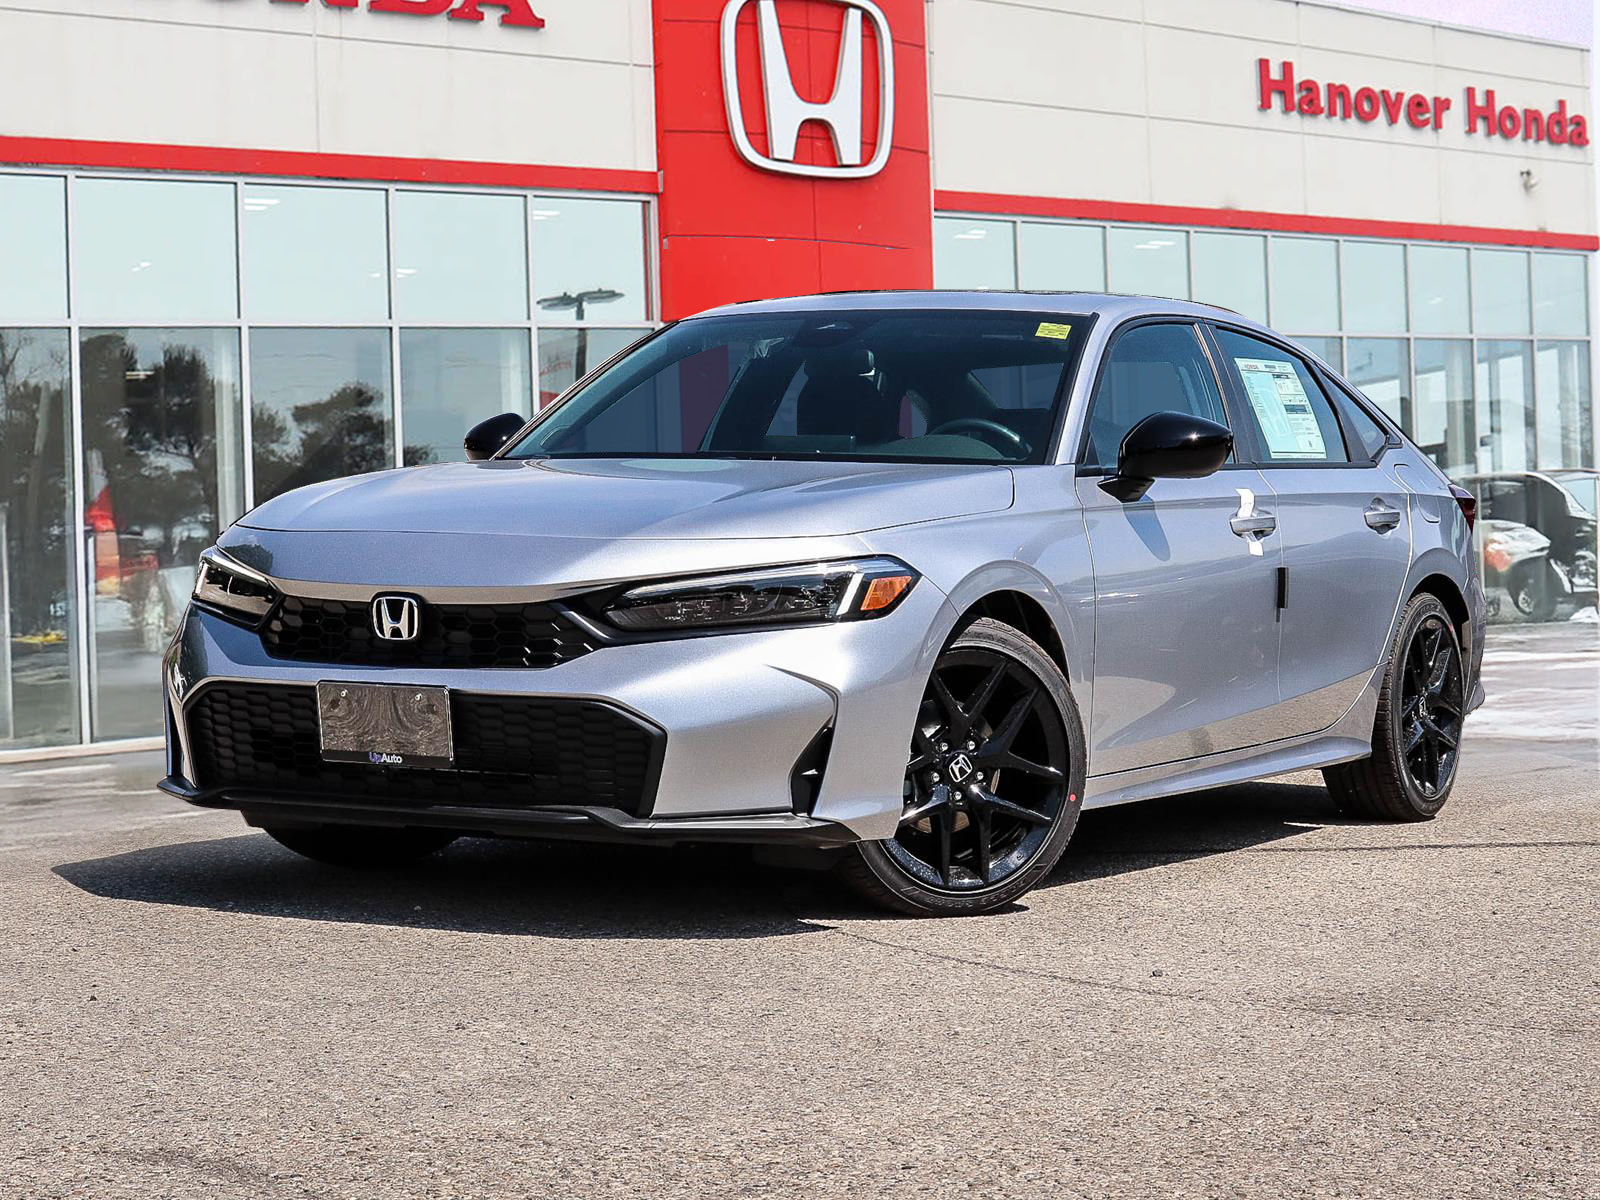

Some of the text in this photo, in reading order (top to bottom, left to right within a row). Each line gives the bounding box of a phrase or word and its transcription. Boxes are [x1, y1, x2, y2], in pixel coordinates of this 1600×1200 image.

[1257, 58, 1589, 147] Hanover Honda
[368, 751, 403, 764] UpAuto
